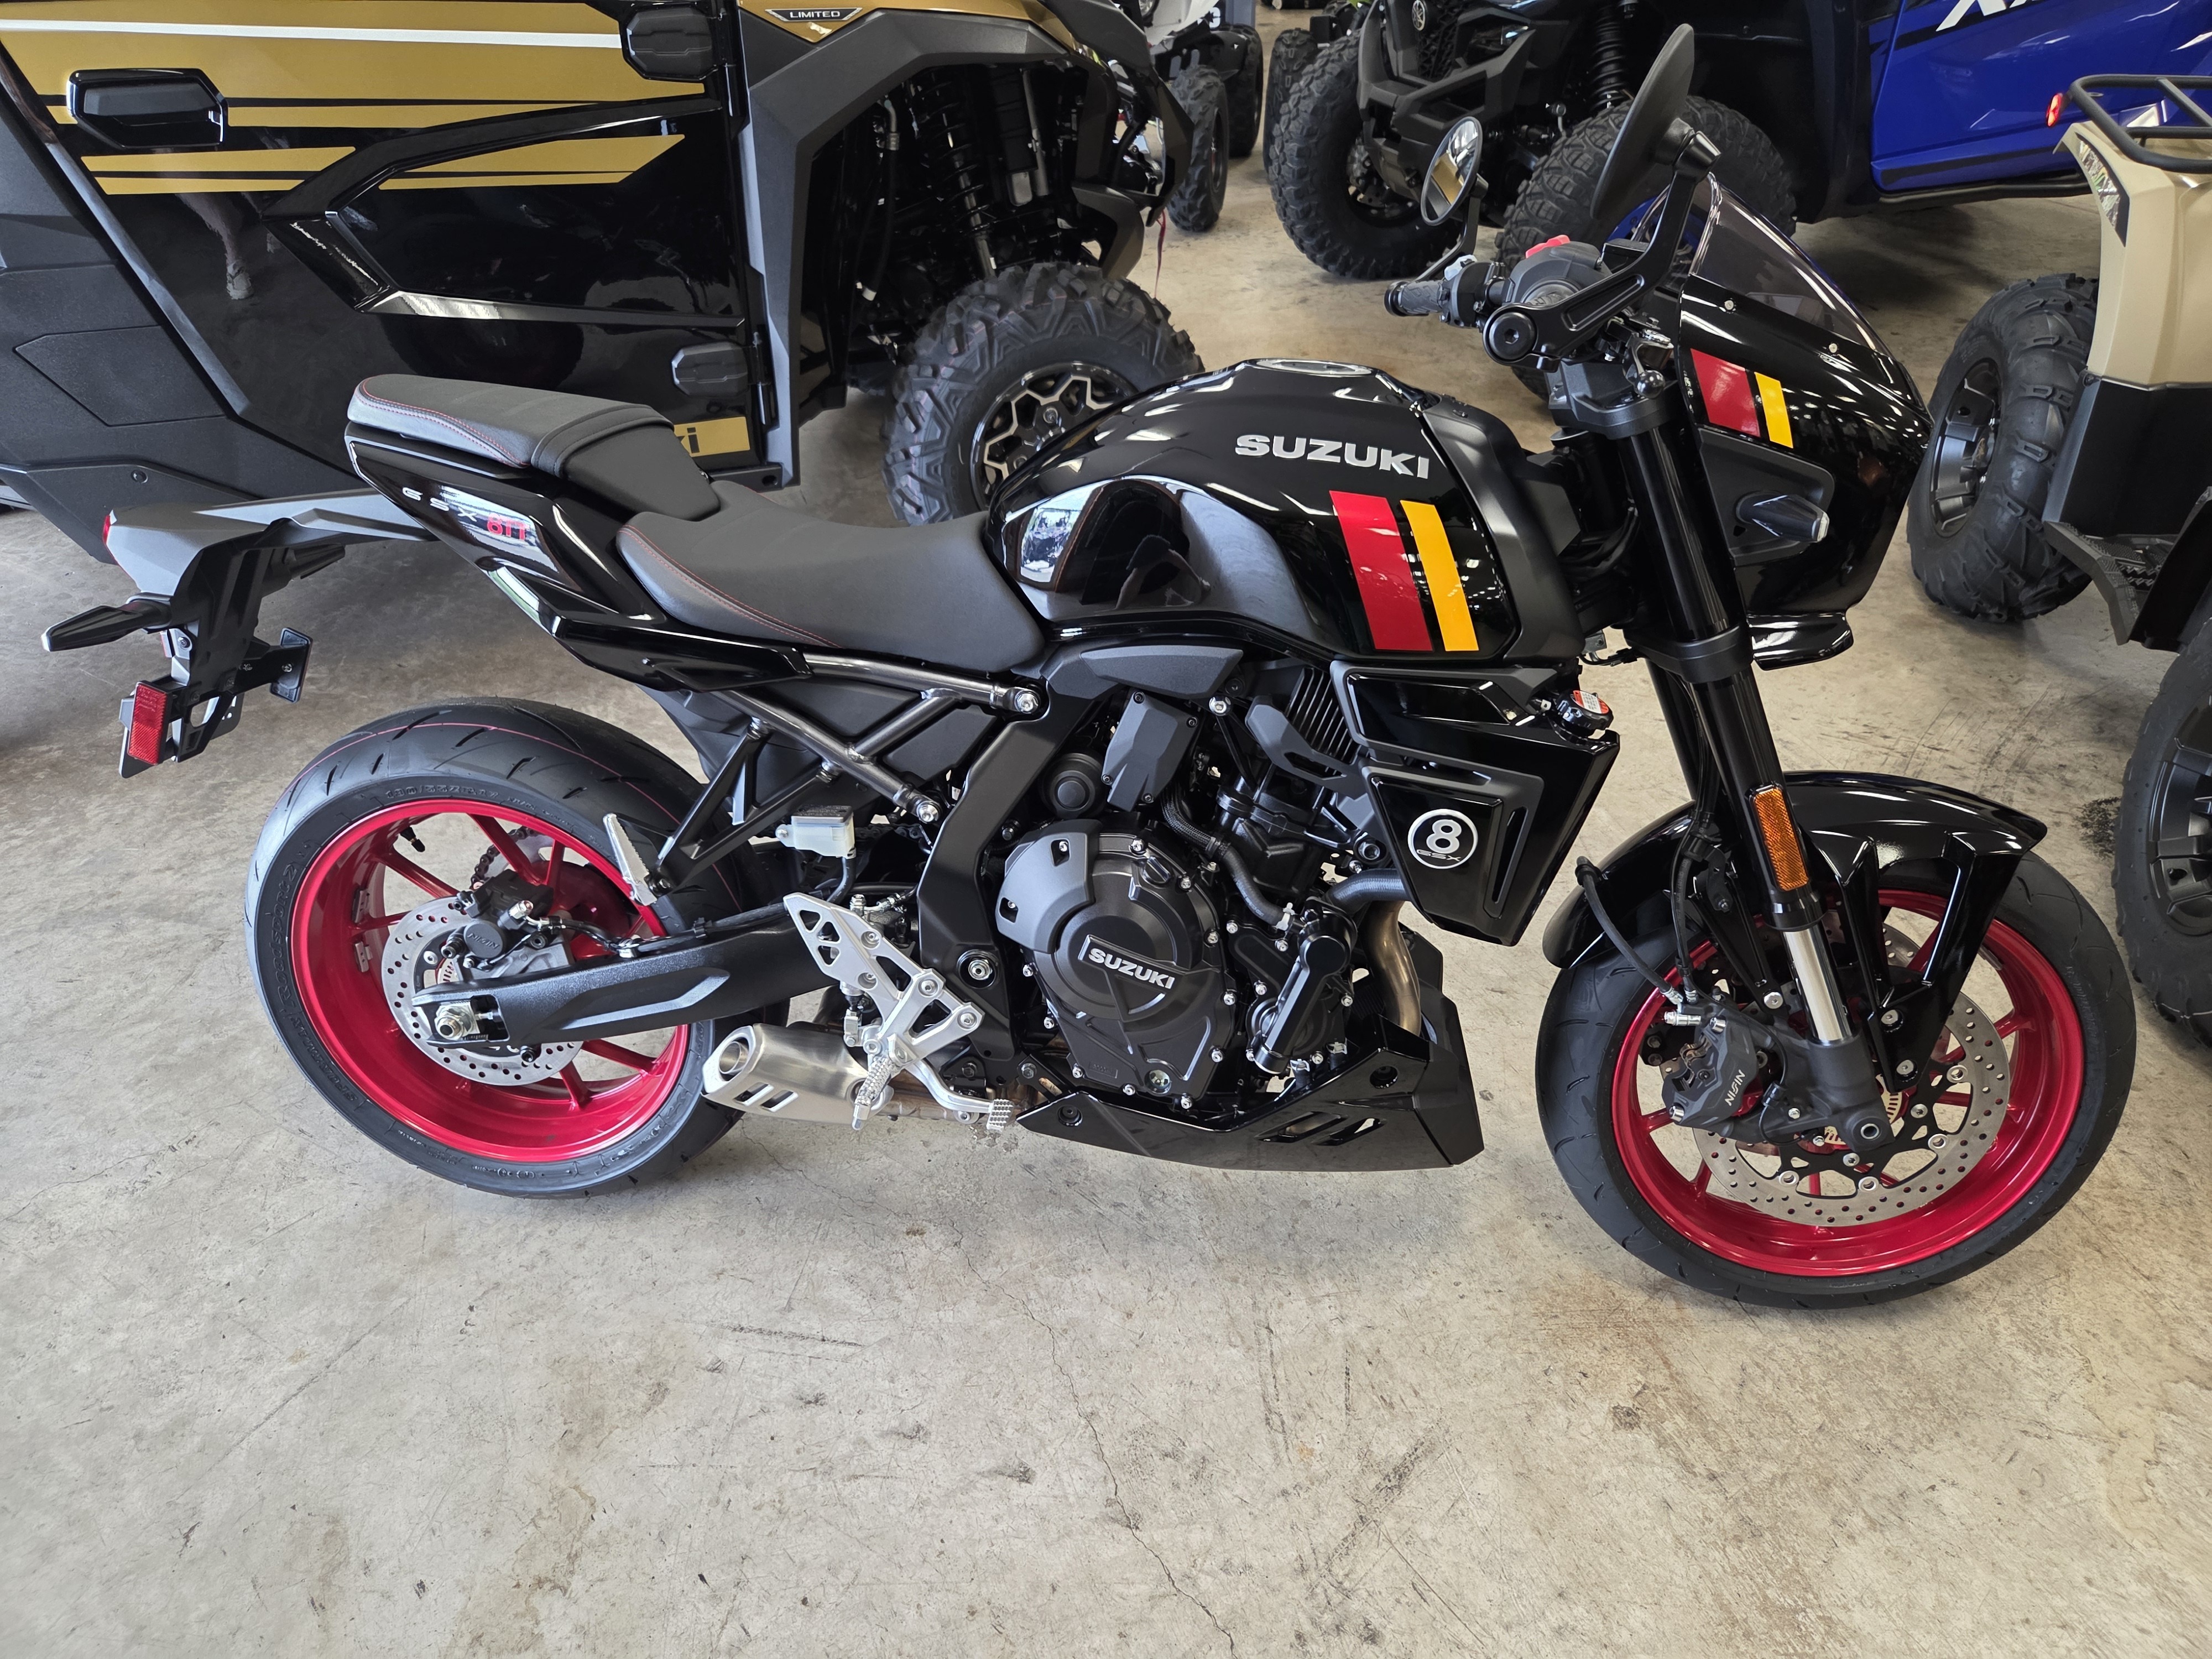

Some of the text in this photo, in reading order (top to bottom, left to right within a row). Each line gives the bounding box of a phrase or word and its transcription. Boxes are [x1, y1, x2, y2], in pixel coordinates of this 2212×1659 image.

[1235, 434, 1430, 479] SUZUKI
[1416, 849, 1462, 862] GSX
[1426, 819, 1462, 854] 8
[1088, 948, 1175, 989] SUZUKI
[1725, 1069, 1745, 1107] NISSIN
